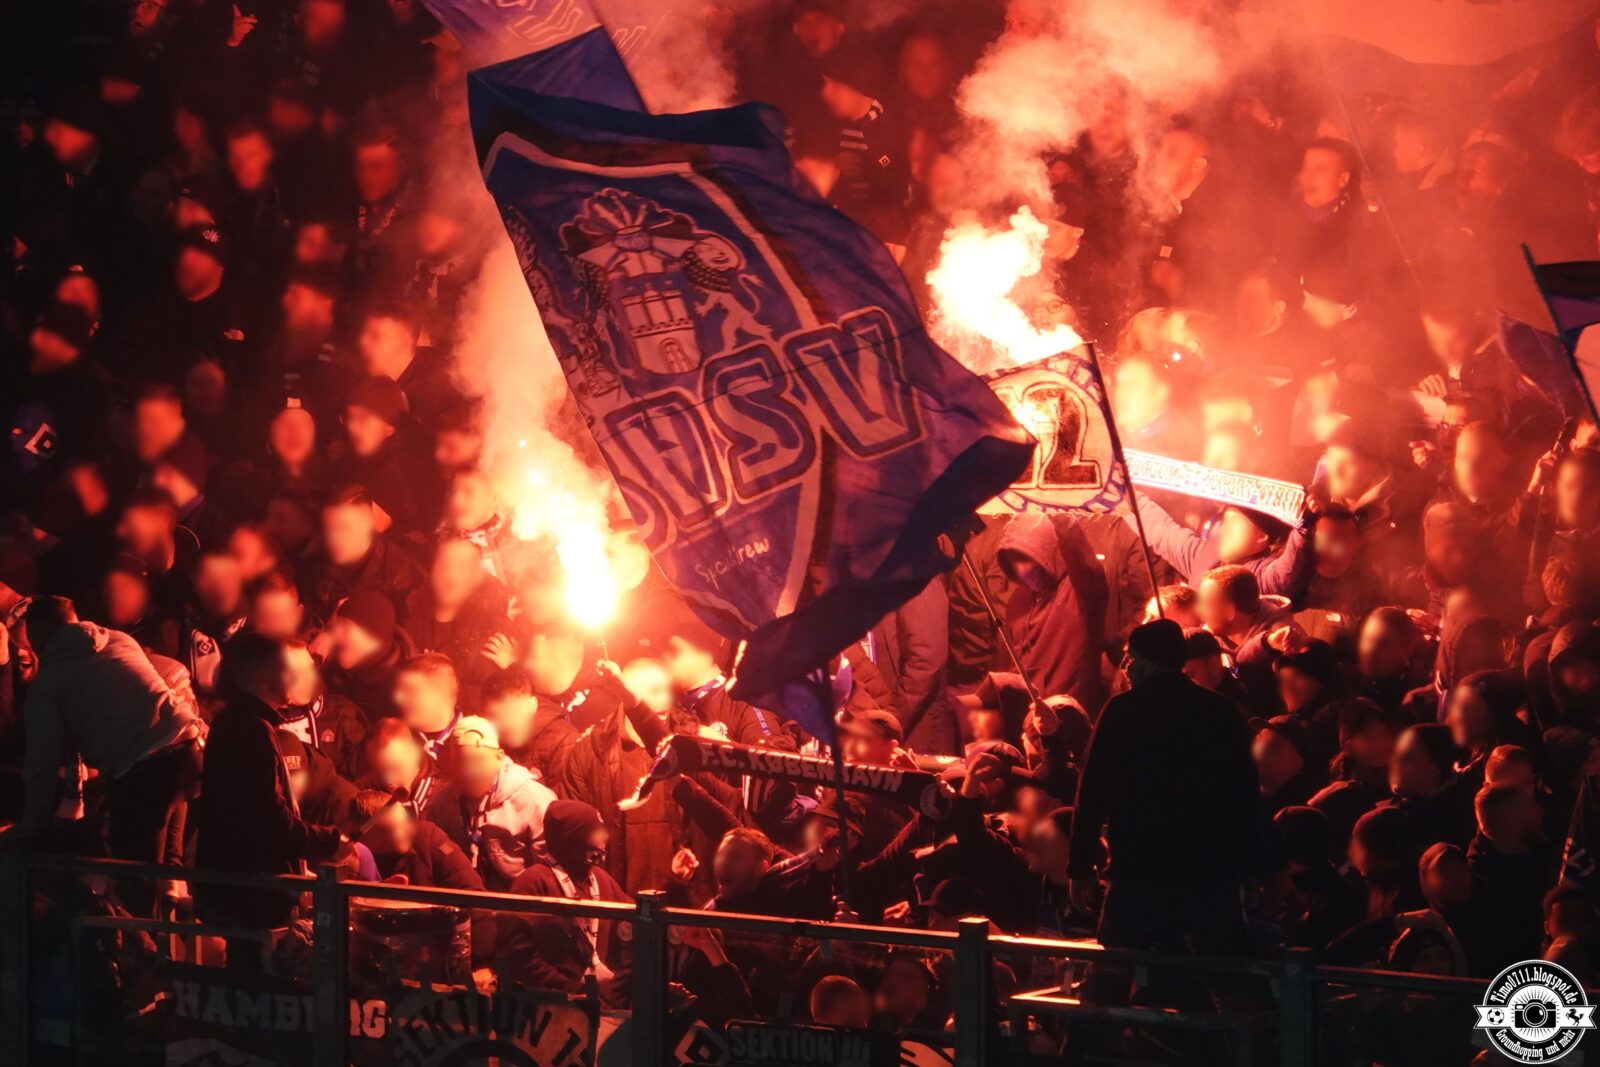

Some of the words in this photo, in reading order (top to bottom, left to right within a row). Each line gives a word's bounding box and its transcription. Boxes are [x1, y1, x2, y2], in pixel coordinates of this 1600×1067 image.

[698, 742, 745, 769] F.C.
[172, 979, 388, 1039] HAMBG
[729, 1025, 834, 1064] SEKTION
